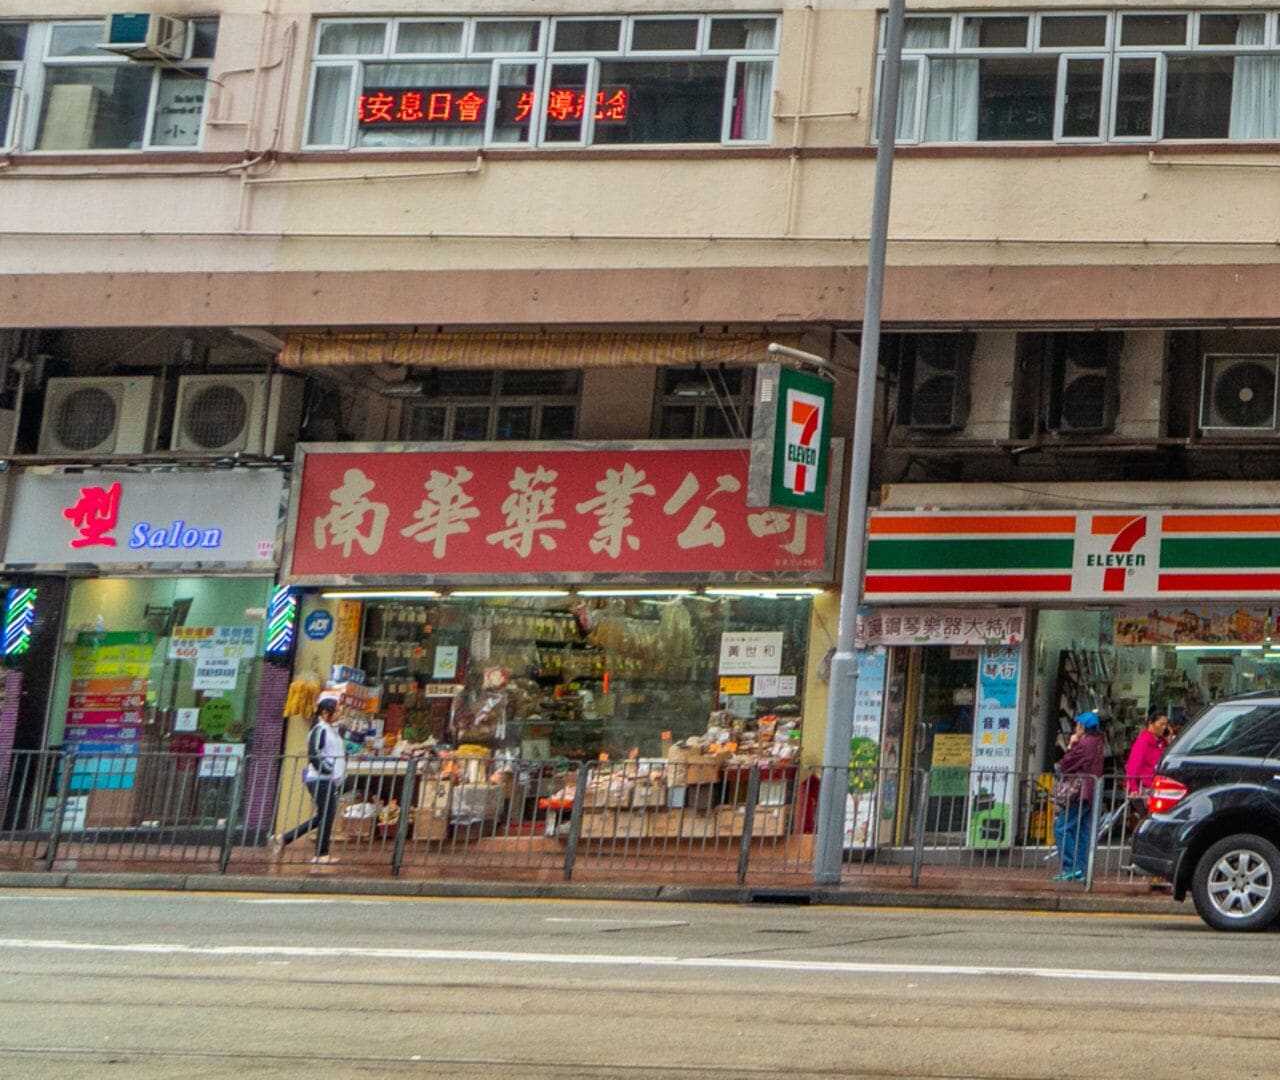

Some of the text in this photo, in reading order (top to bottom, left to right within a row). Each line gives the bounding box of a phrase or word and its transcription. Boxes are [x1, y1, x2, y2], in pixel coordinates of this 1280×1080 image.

[61, 481, 122, 549] 型
[128, 520, 222, 550] Salon
[313, 462, 808, 558] 南華藥業公司
[1091, 515, 1147, 591] 7
[727, 645, 776, 659] 黃世和
